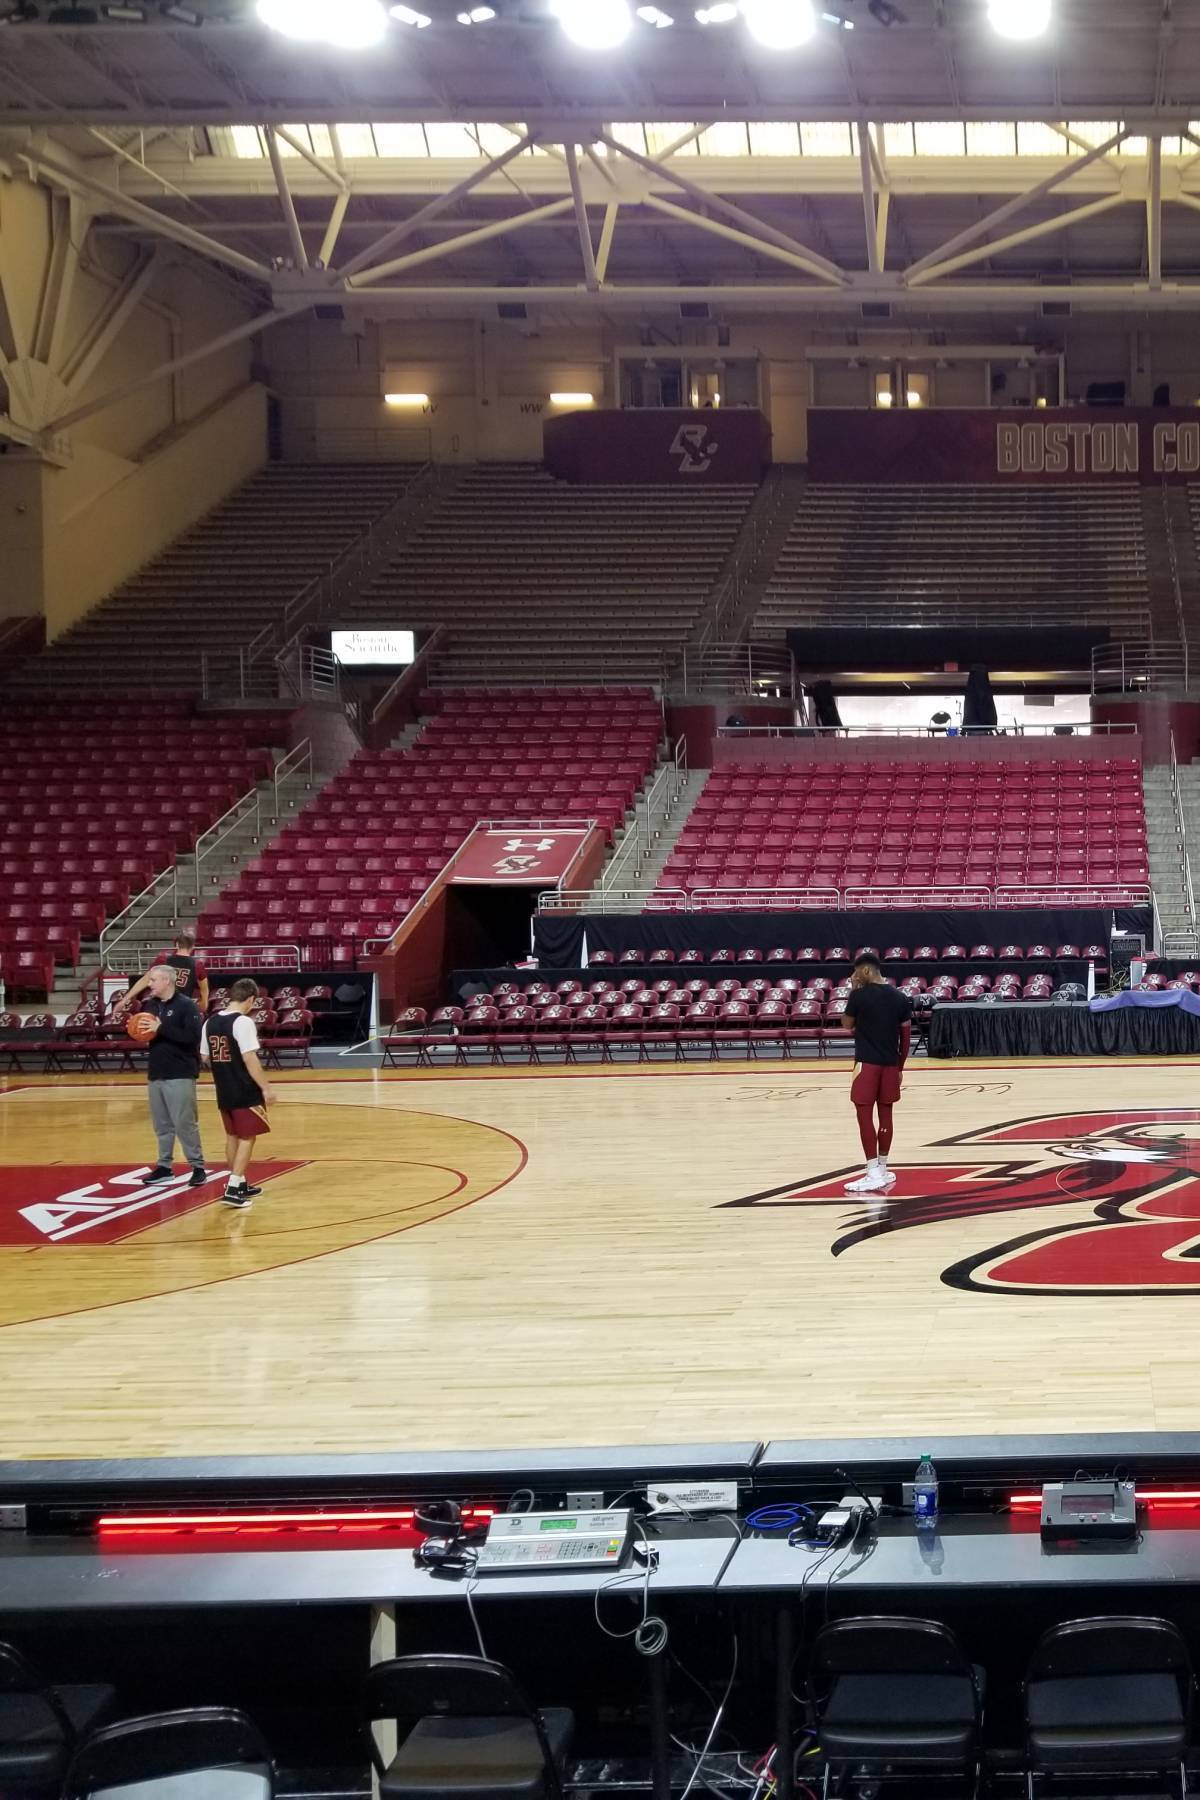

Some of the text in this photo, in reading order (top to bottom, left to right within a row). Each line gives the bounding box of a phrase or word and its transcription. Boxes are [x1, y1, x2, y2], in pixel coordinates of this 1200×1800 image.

[996, 422, 1139, 473] BOSTON
[174, 967, 191, 988] 5
[208, 1035, 232, 1062] 22
